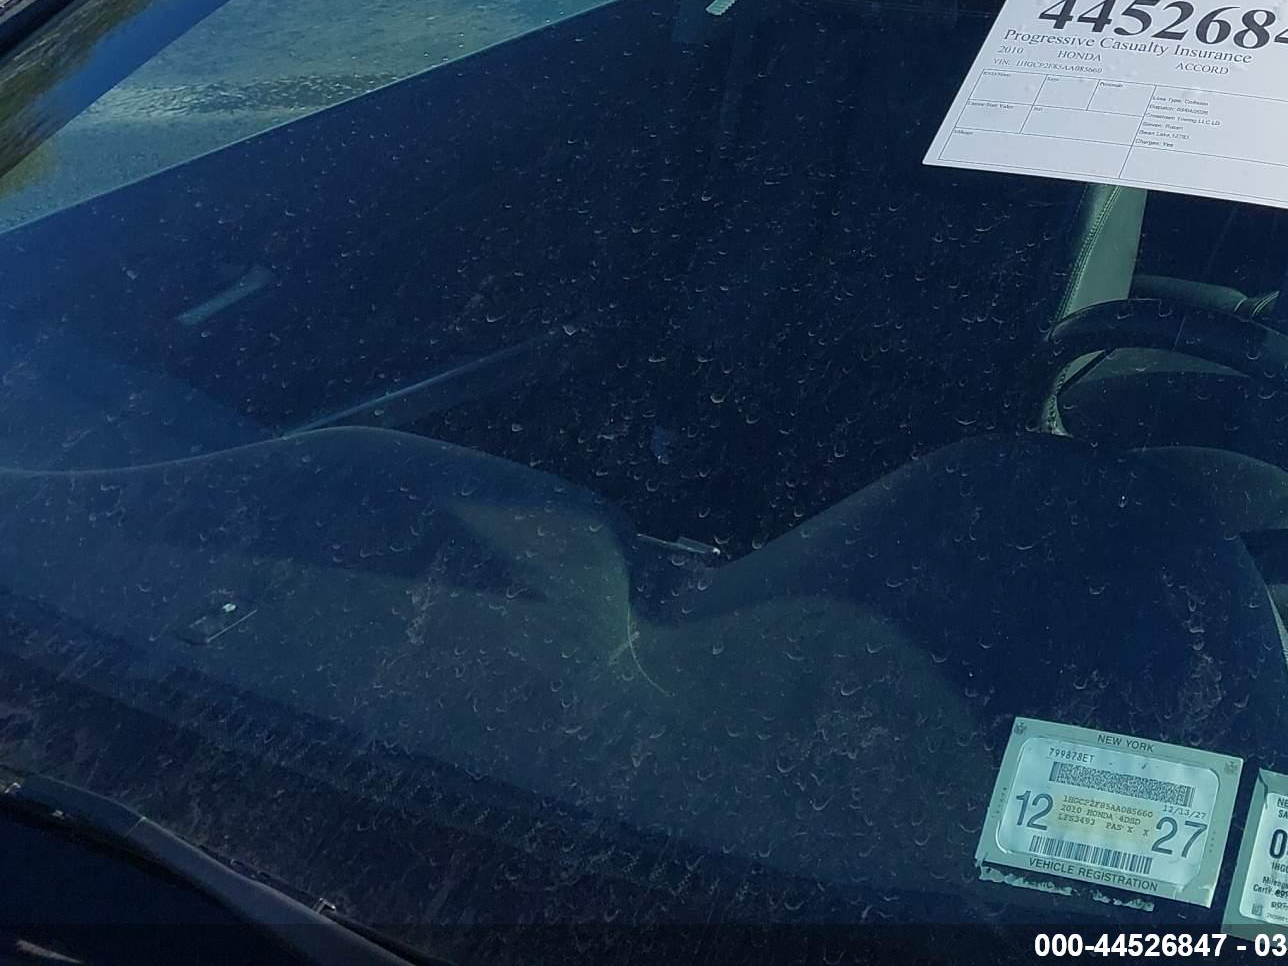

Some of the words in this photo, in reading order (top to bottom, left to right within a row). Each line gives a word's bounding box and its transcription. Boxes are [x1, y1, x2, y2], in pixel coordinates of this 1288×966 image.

[998, 45, 1024, 54] 2010
[1057, 50, 1102, 62] HONDA
[1175, 62, 1229, 75] ACCORD
[1003, 29, 1095, 47] Progressive
[1100, 37, 1169, 56] Casualty
[1174, 44, 1252, 64] Insurance
[1048, 747, 1096, 764] 799878ET
[1097, 734, 1121, 747] NEW
[1125, 738, 1155, 753] YORK
[1015, 790, 1054, 831] 12
[1060, 804, 1082, 814] 2010
[1086, 809, 1113, 821] HONDA
[1162, 804, 1207, 820] 12/13/27
[1151, 816, 1209, 859] 27
[1029, 858, 1075, 876] VEHICLE
[1077, 866, 1158, 892] REGISTRATION
